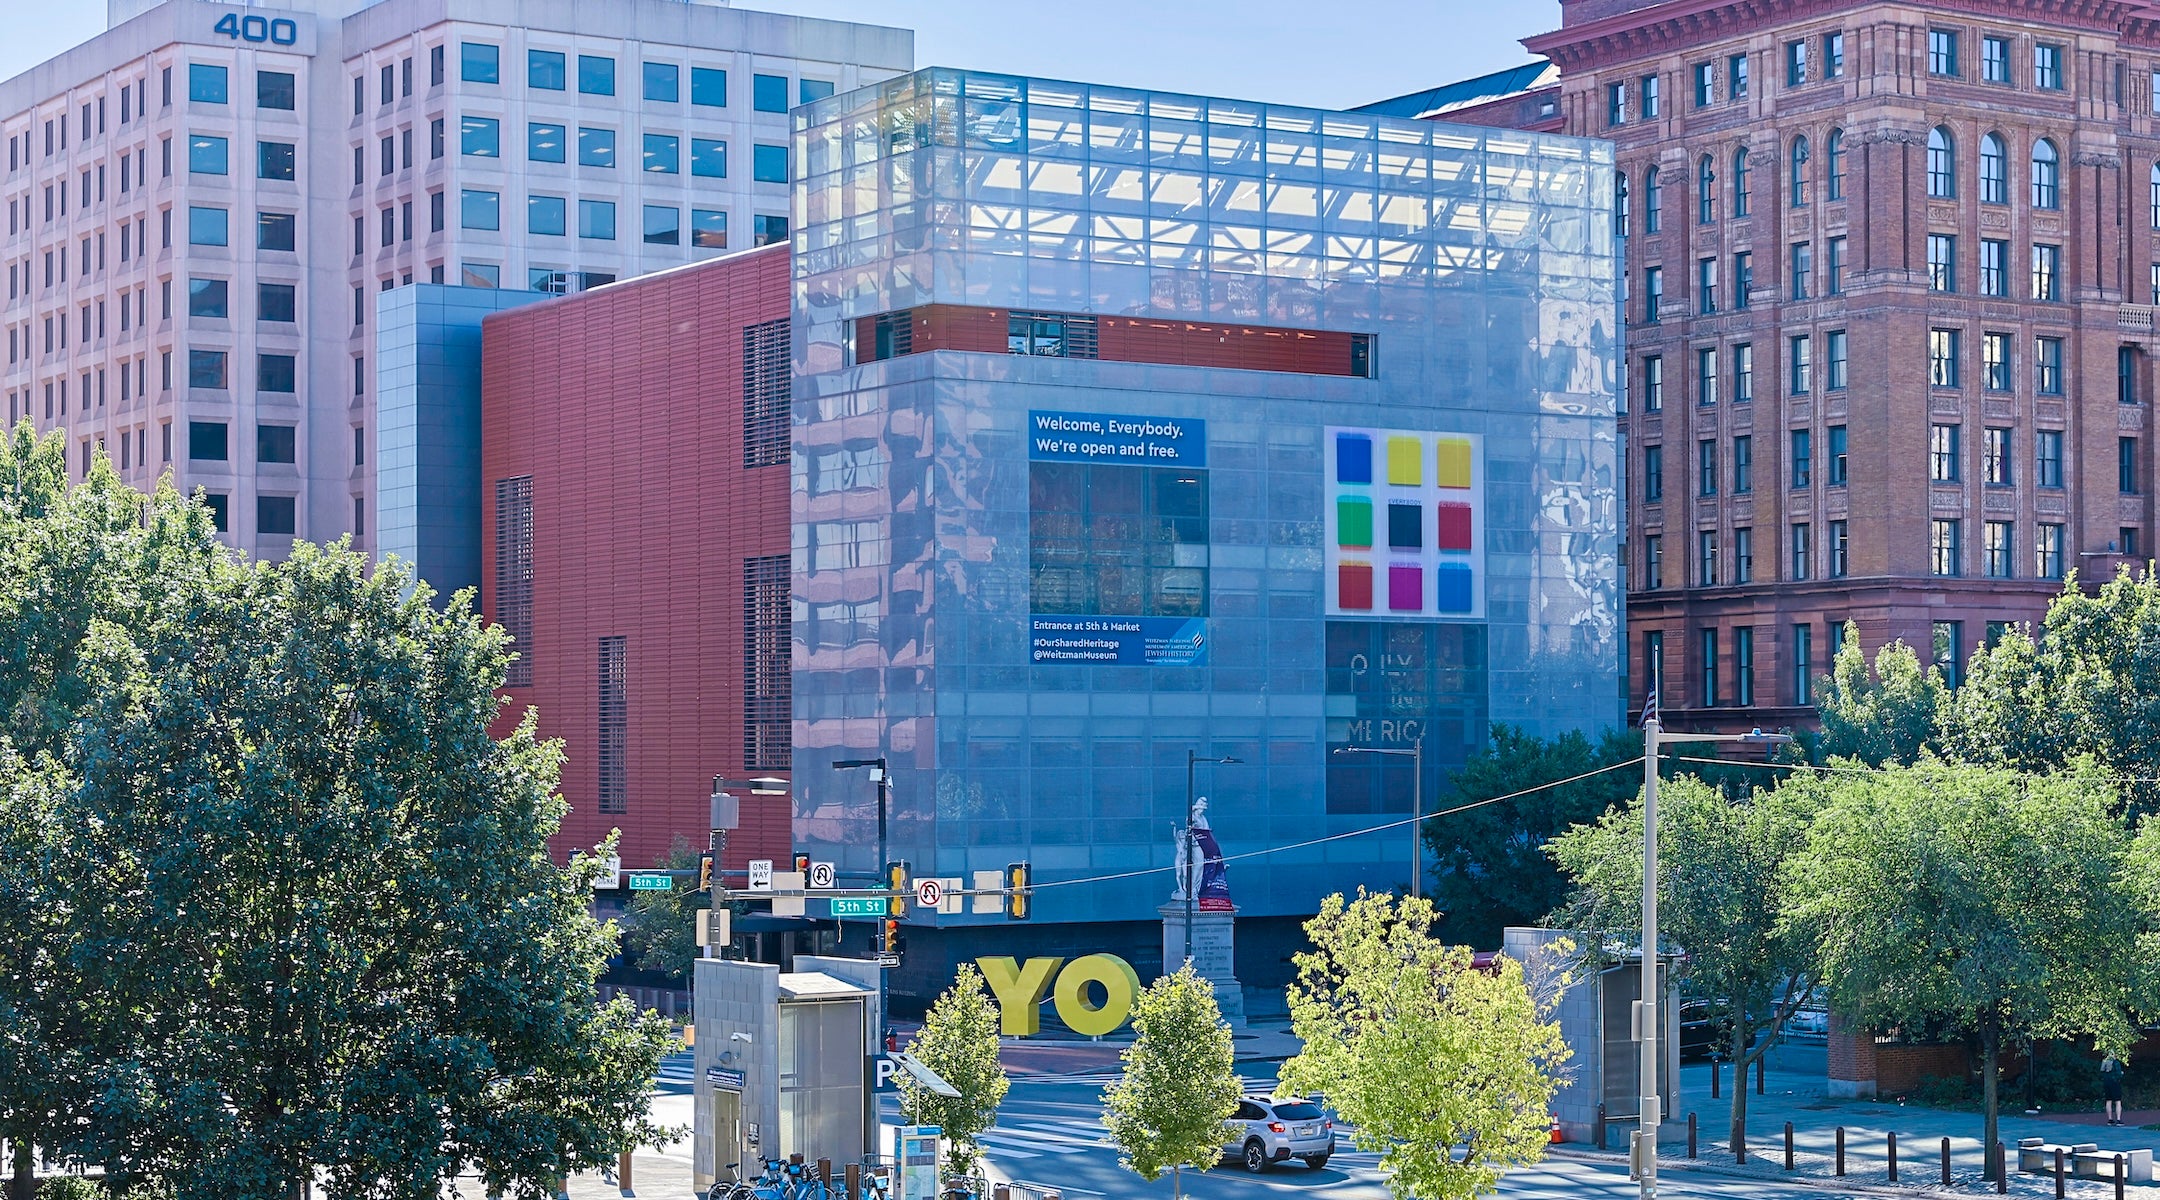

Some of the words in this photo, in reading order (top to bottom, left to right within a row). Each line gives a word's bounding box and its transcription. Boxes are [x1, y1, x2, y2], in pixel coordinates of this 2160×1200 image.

[214, 13, 296, 46] 400
[1036, 416, 1105, 435] Welcome,
[1109, 420, 1184, 439] Everybody.
[1036, 438, 1077, 453] We're
[1081, 443, 1116, 457] open
[1119, 442, 1145, 456] and
[1149, 442, 1179, 458] free.
[1034, 620, 1072, 631] Entrance
[1074, 622, 1084, 631] at
[1086, 621, 1100, 631] 5th
[1102, 622, 1108, 631] &
[1111, 622, 1140, 632] Market
[1034, 638, 1119, 650] #OurSharedHeritage
[1034, 650, 1118, 661] @WeitzmanMuseum
[752, 863, 769, 871] ONE
[752, 870, 769, 879] WAY
[635, 878, 652, 887] 5th
[655, 878, 667, 887] St
[838, 901, 860, 913] 5th
[866, 901, 880, 913] St
[975, 952, 1141, 1037] YO
